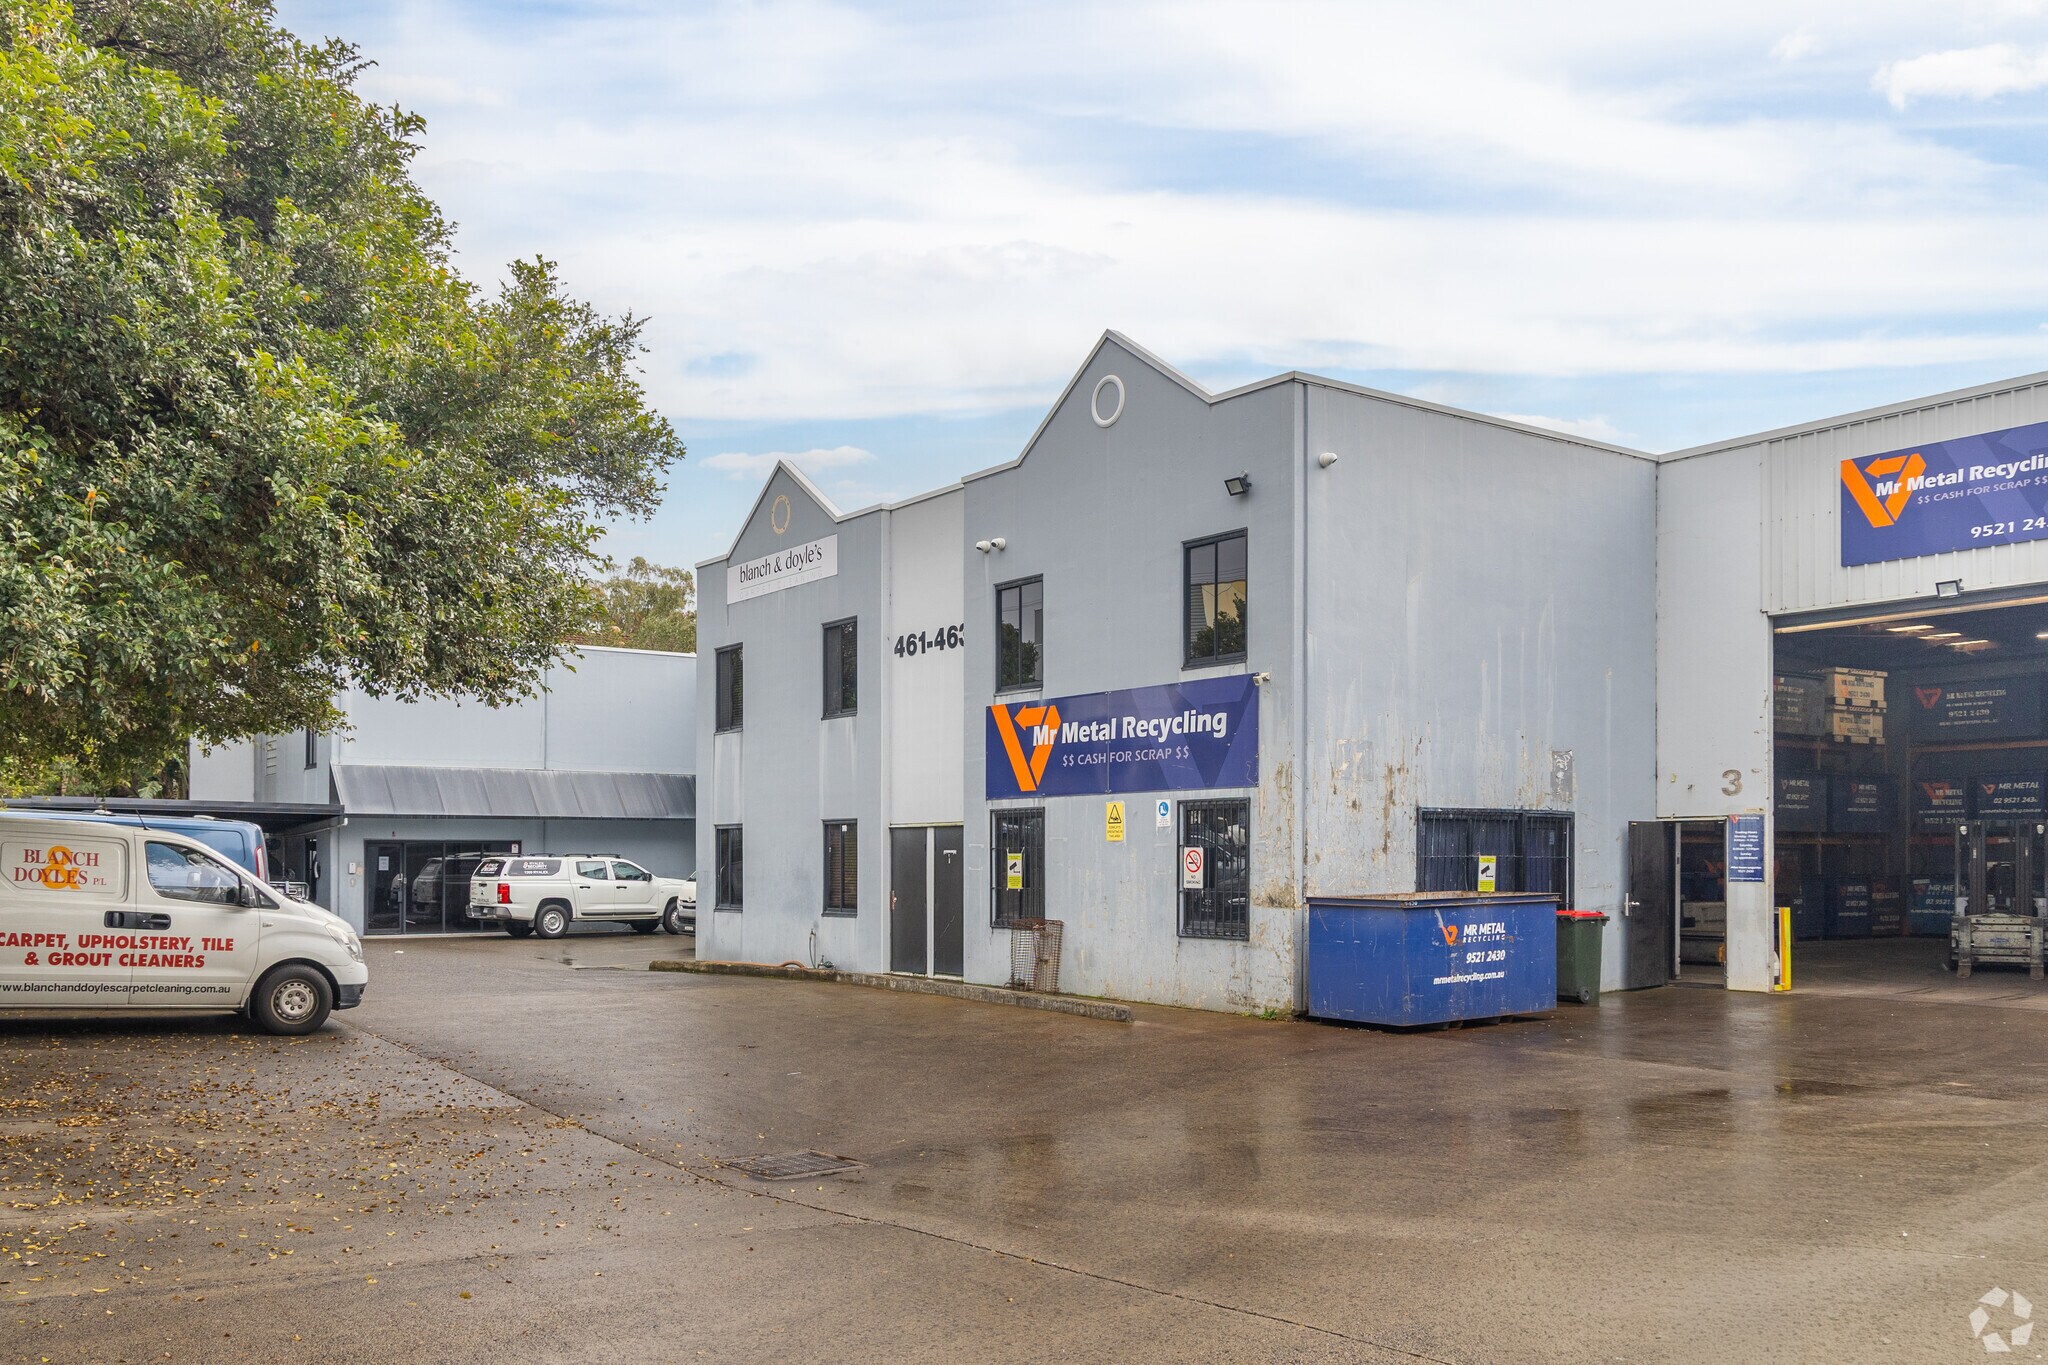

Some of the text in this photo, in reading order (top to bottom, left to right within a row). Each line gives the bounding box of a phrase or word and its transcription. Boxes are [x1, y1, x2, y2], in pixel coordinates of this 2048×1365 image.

[1876, 453, 2048, 497] Mr Metal Recycli
[1934, 489, 1964, 502] CASH
[1967, 486, 1990, 496] FOR
[1993, 479, 2031, 492] SCRAP
[1970, 516, 2048, 539] 9521 24
[739, 544, 822, 583] blanch & doyle's
[1032, 709, 1228, 747] Mr Metal Recycling
[1062, 745, 1190, 767] $$ CASH FOR SCRAP $$
[1721, 769, 1743, 796] 3
[1998, 781, 2039, 790] MR METAL
[23, 849, 100, 867] BLANCH
[41, 845, 81, 890] &
[13, 866, 88, 885] DOYLES
[1463, 922, 1506, 936] MR METAL
[78, 934, 194, 953] UPHOLSTERY,
[201, 937, 234, 951] TILE
[24, 951, 205, 968] & GROUT CLEANERS
[1466, 950, 1506, 964] 9521 2430
[1433, 971, 1505, 985] mrmetalrecycling.com.au
[0, 982, 231, 995] ww.blanchanddoylescarpetcleaning.com.au
